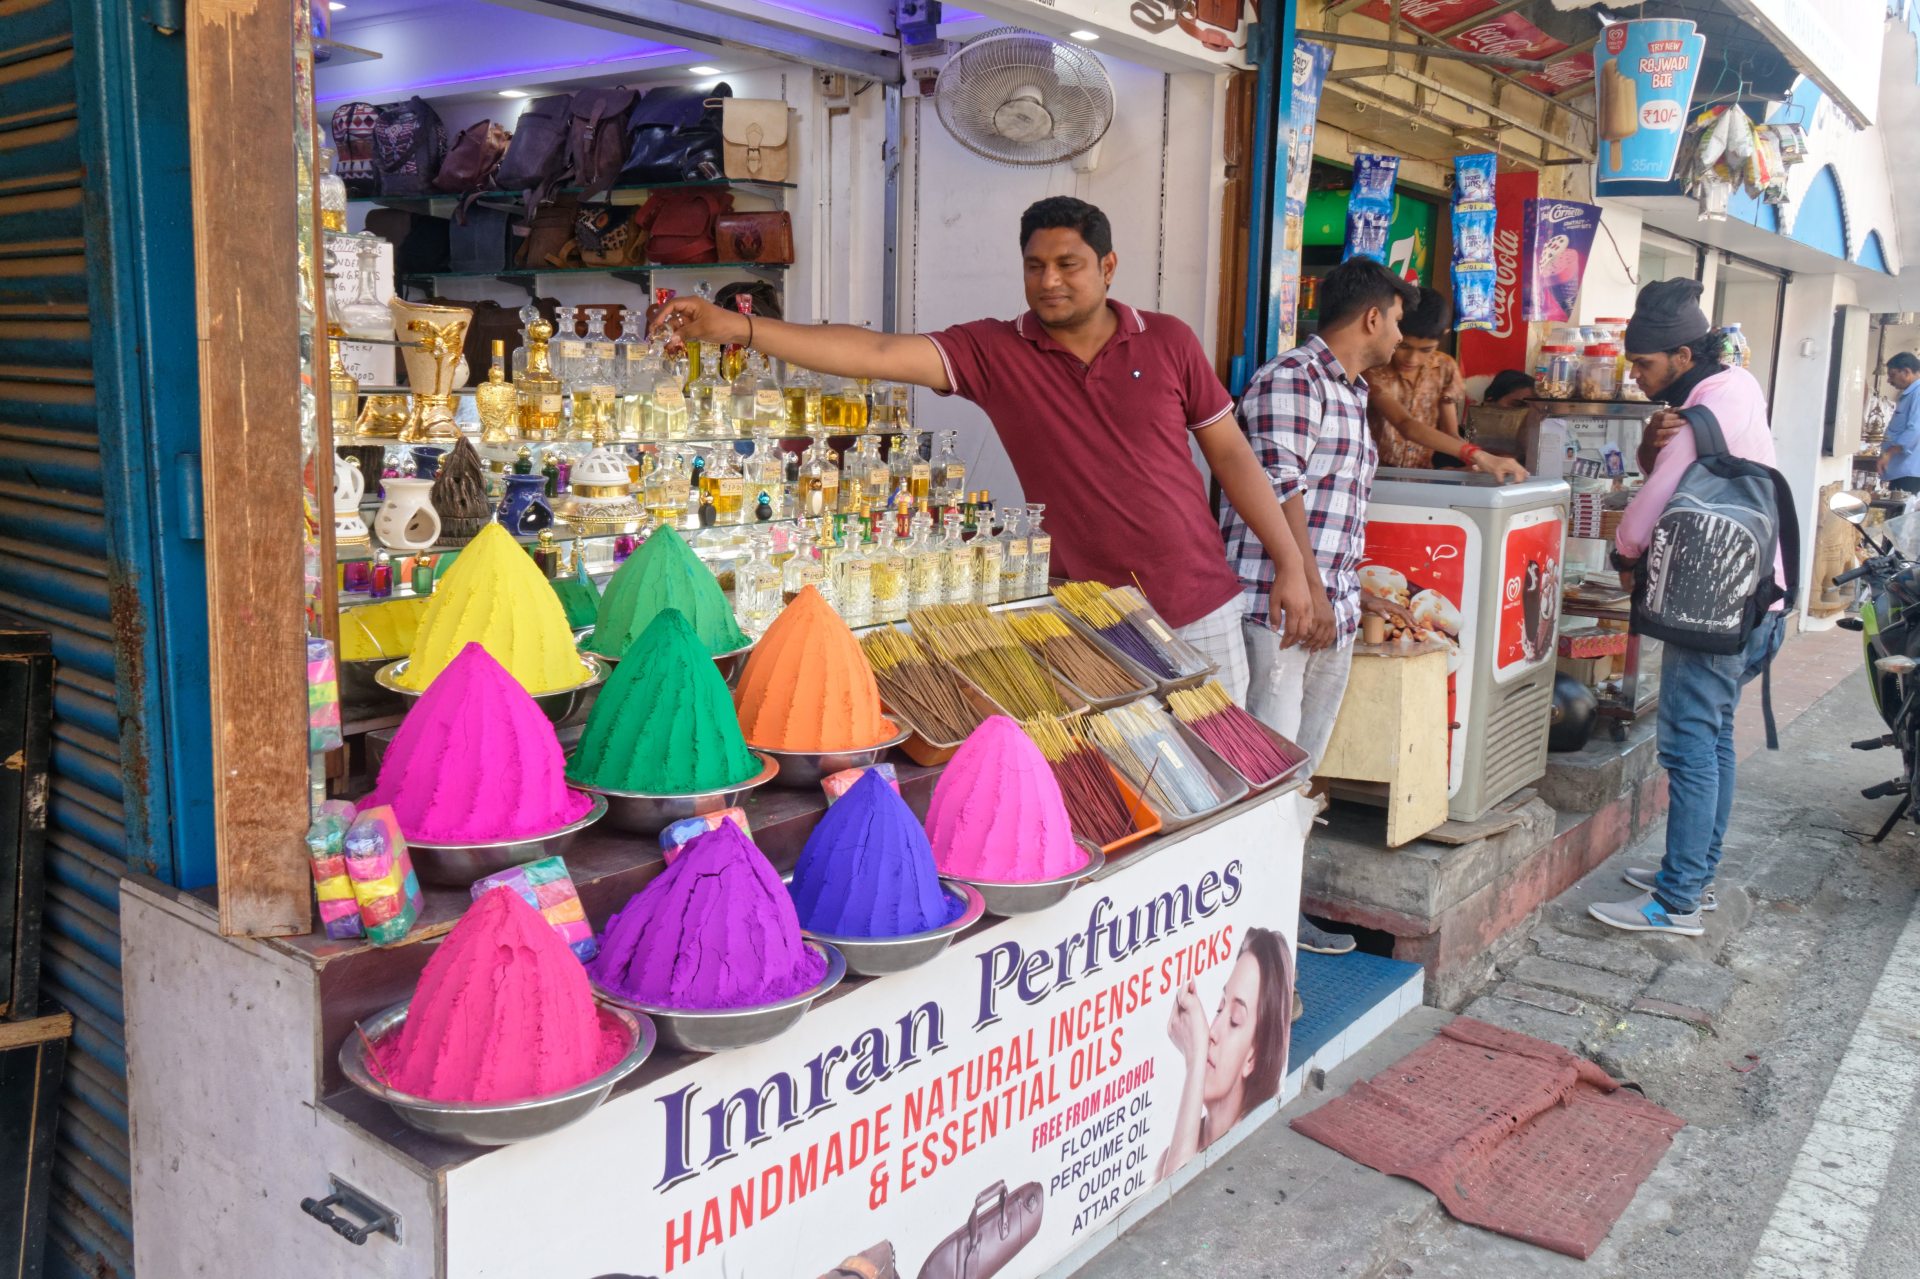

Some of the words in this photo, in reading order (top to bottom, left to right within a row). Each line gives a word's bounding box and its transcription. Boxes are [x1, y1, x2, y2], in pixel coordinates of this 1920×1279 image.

[1639, 56, 1688, 73] RAJWADI
[1650, 43, 1664, 52] TRY
[1666, 41, 1681, 51] NEW
[1642, 108, 1678, 124] ₹10/-
[1631, 159, 1662, 172] 35ml
[654, 1001, 949, 1194] Imran
[972, 859, 1243, 1032] Perfumes
[665, 1104, 892, 1273] HANDMADE
[903, 1028, 1038, 1139] NATURAL
[1048, 966, 1152, 1057] INCENSE
[1159, 925, 1233, 996] STICKS
[869, 1162, 889, 1210] &
[900, 1065, 1061, 1192] ESSENTIAL
[1069, 1026, 1124, 1090] OILS
[1032, 1114, 1062, 1153] FREE
[1066, 1091, 1101, 1131] FROM
[1103, 1057, 1155, 1108] ALCOHOL
[1061, 1106, 1126, 1162] FLOWER
[1130, 1091, 1153, 1117] OIL
[1050, 1131, 1124, 1197] PERFUME
[1128, 1118, 1150, 1144] OIL
[1079, 1161, 1122, 1203] OUDH
[1126, 1144, 1148, 1170] OIL
[1072, 1188, 1119, 1235] ATTAR
[1124, 1170, 1145, 1196] OIL
